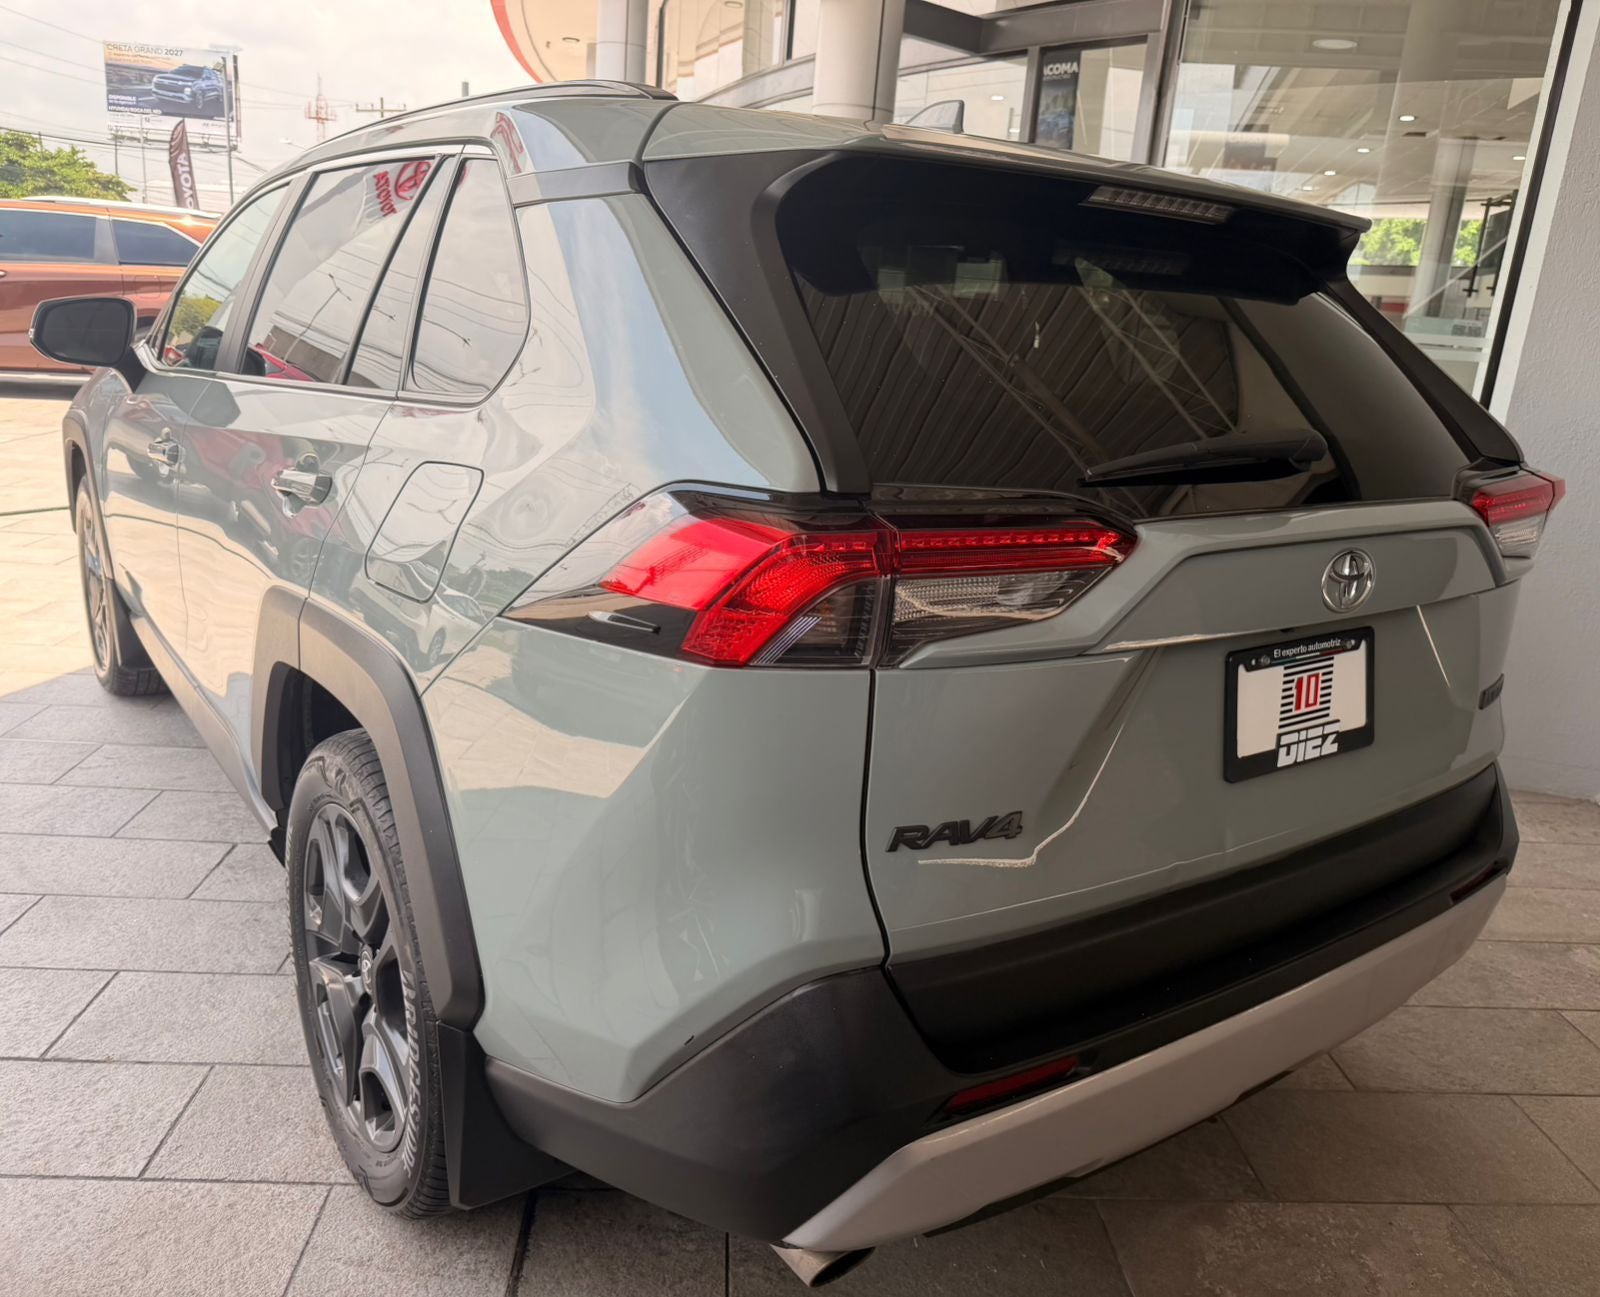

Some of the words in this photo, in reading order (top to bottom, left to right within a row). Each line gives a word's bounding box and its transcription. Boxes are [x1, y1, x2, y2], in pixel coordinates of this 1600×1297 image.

[106, 43, 133, 52] CRETA
[134, 45, 163, 55] GRAND
[177, 152, 194, 210] OYOTA
[1273, 648, 1281, 658] El
[1282, 643, 1307, 657] experto
[1308, 638, 1341, 651] automotriz
[1294, 672, 1320, 711] 10
[1277, 722, 1341, 768] DIEZ
[885, 810, 1023, 852] RAV4
